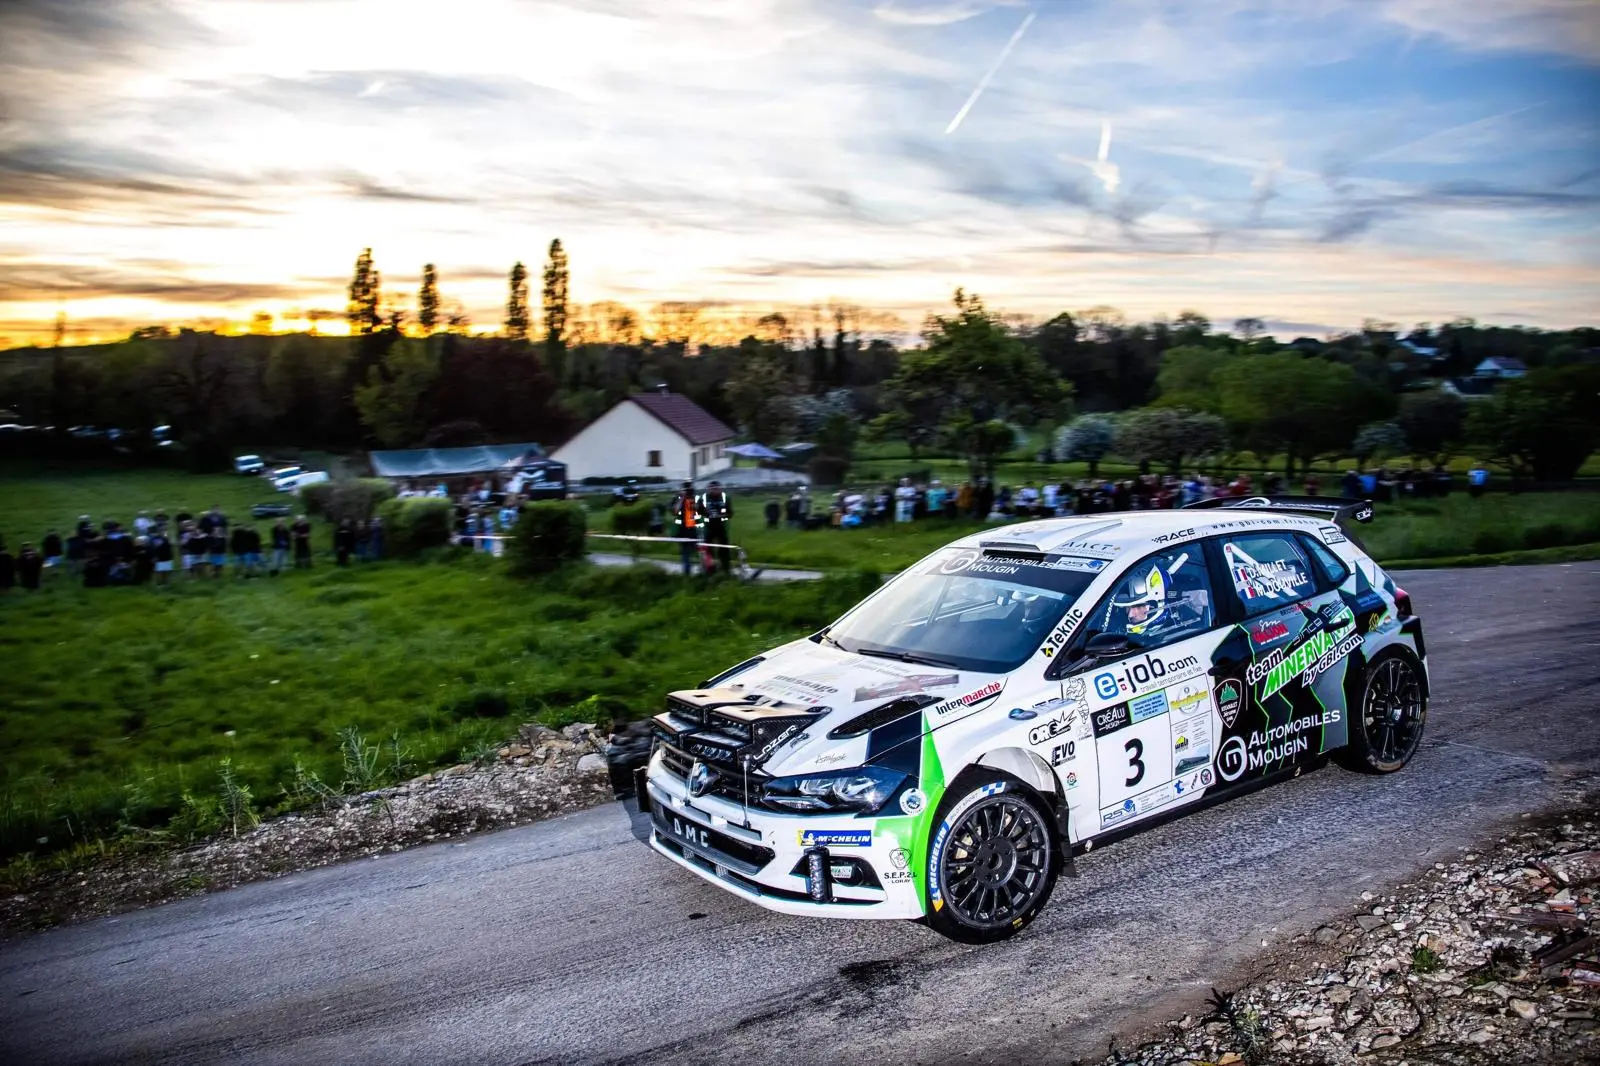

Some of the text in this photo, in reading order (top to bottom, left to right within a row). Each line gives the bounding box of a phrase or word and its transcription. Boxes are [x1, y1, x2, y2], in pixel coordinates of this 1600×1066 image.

[1158, 528, 1196, 544] RACE
[967, 564, 1020, 575] MOUGIN
[977, 554, 1057, 570] AUTOMOBILES
[1048, 608, 1083, 649] Teknic
[1246, 647, 1285, 686] team
[1260, 628, 1336, 703] MINERVA
[1248, 709, 1341, 750] AUTOMOBILES
[1052, 741, 1075, 767] EVO
[1124, 738, 1146, 788] 3
[1248, 736, 1308, 771] MOUGIN
[929, 827, 947, 885] MICHELIN
